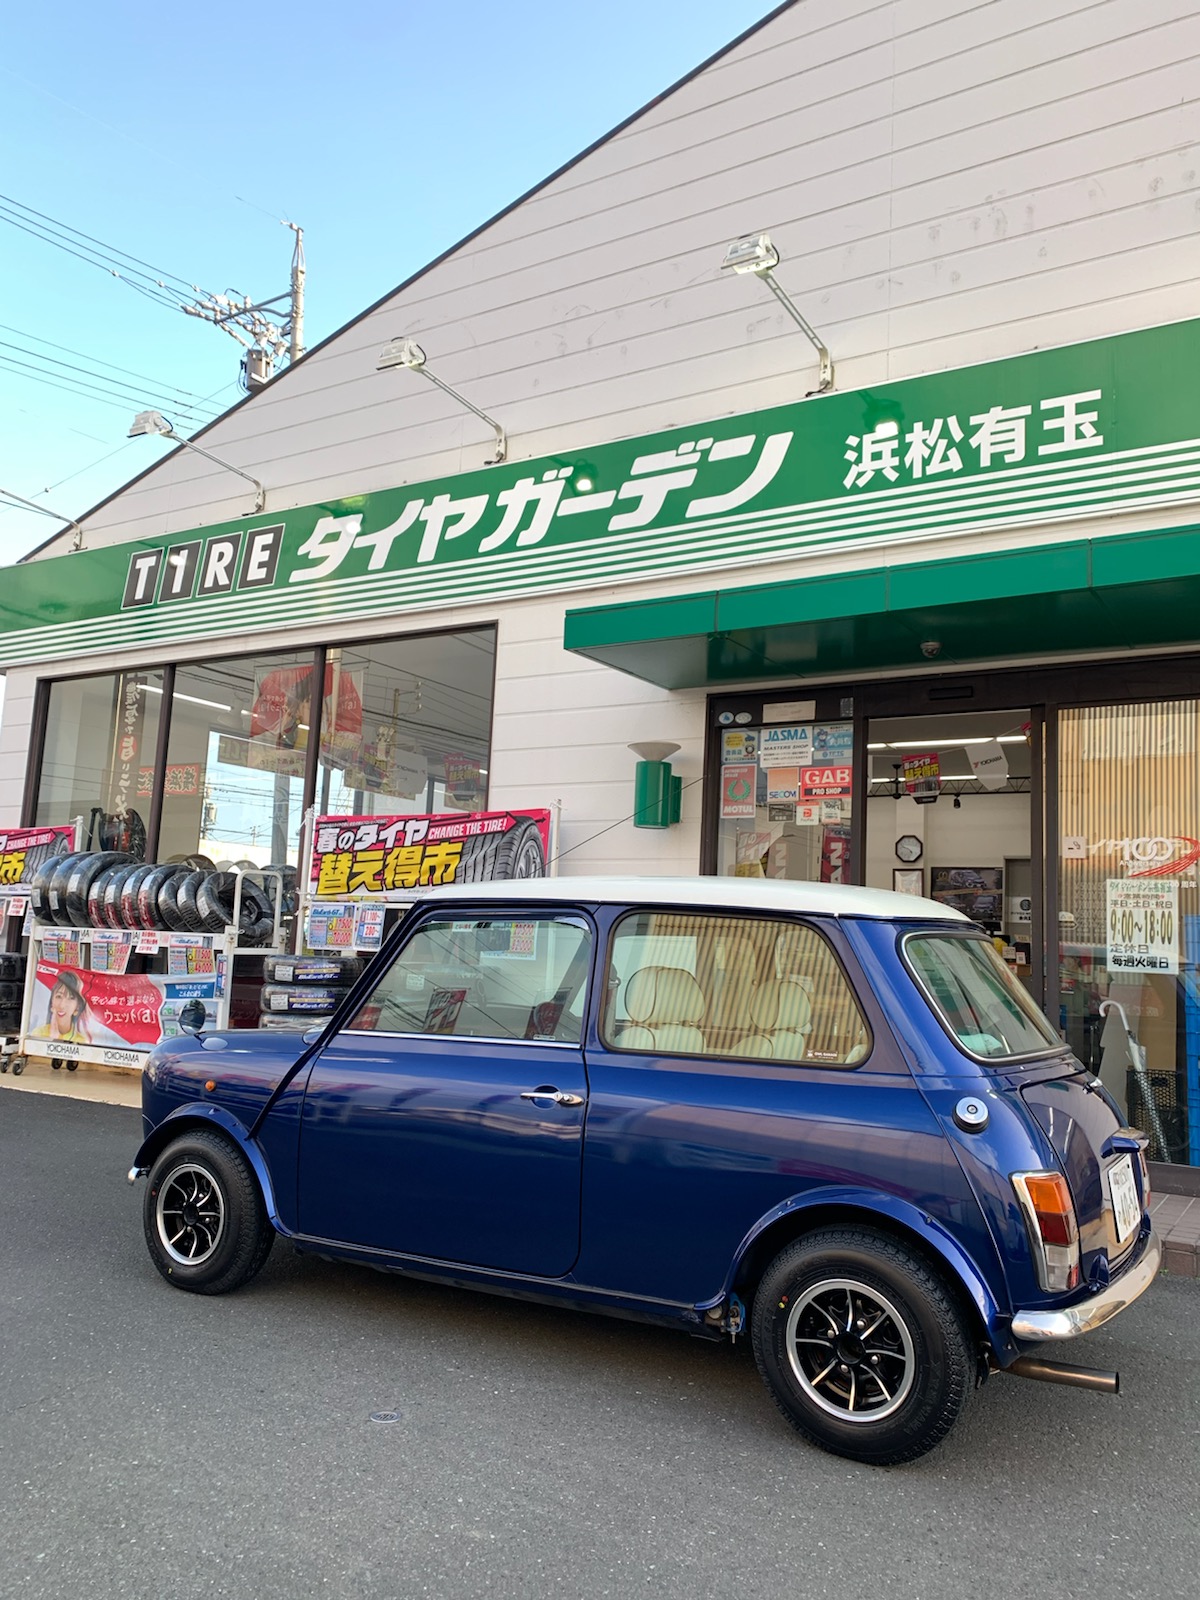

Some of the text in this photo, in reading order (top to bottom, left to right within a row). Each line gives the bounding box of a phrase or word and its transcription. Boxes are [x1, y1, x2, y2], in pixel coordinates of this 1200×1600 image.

[842, 389, 1103, 490] 浜松有玉
[289, 431, 794, 583] タイヤガーデン
[134, 532, 275, 600] TIRE
[764, 728, 808, 742] JASMA
[805, 768, 850, 785] GAB
[769, 790, 797, 799] SECOM
[812, 787, 842, 796] PRO SHOP
[724, 805, 753, 814] MOTUL
[428, 818, 508, 840] CHANGE THE TIRE!
[6, 834, 51, 851] CHANGE THE TIRE!
[316, 819, 430, 854] 春のタイヤ
[317, 841, 464, 895] 替え得市
[1110, 899, 1173, 909] 平日・土日・祝日
[1110, 943, 1149, 954] 定休日
[1112, 955, 1169, 969] 毎週火曜日
[46, 1044, 80, 1056] YOKOHAMA
[103, 1050, 140, 1063] YOKOHAMA
